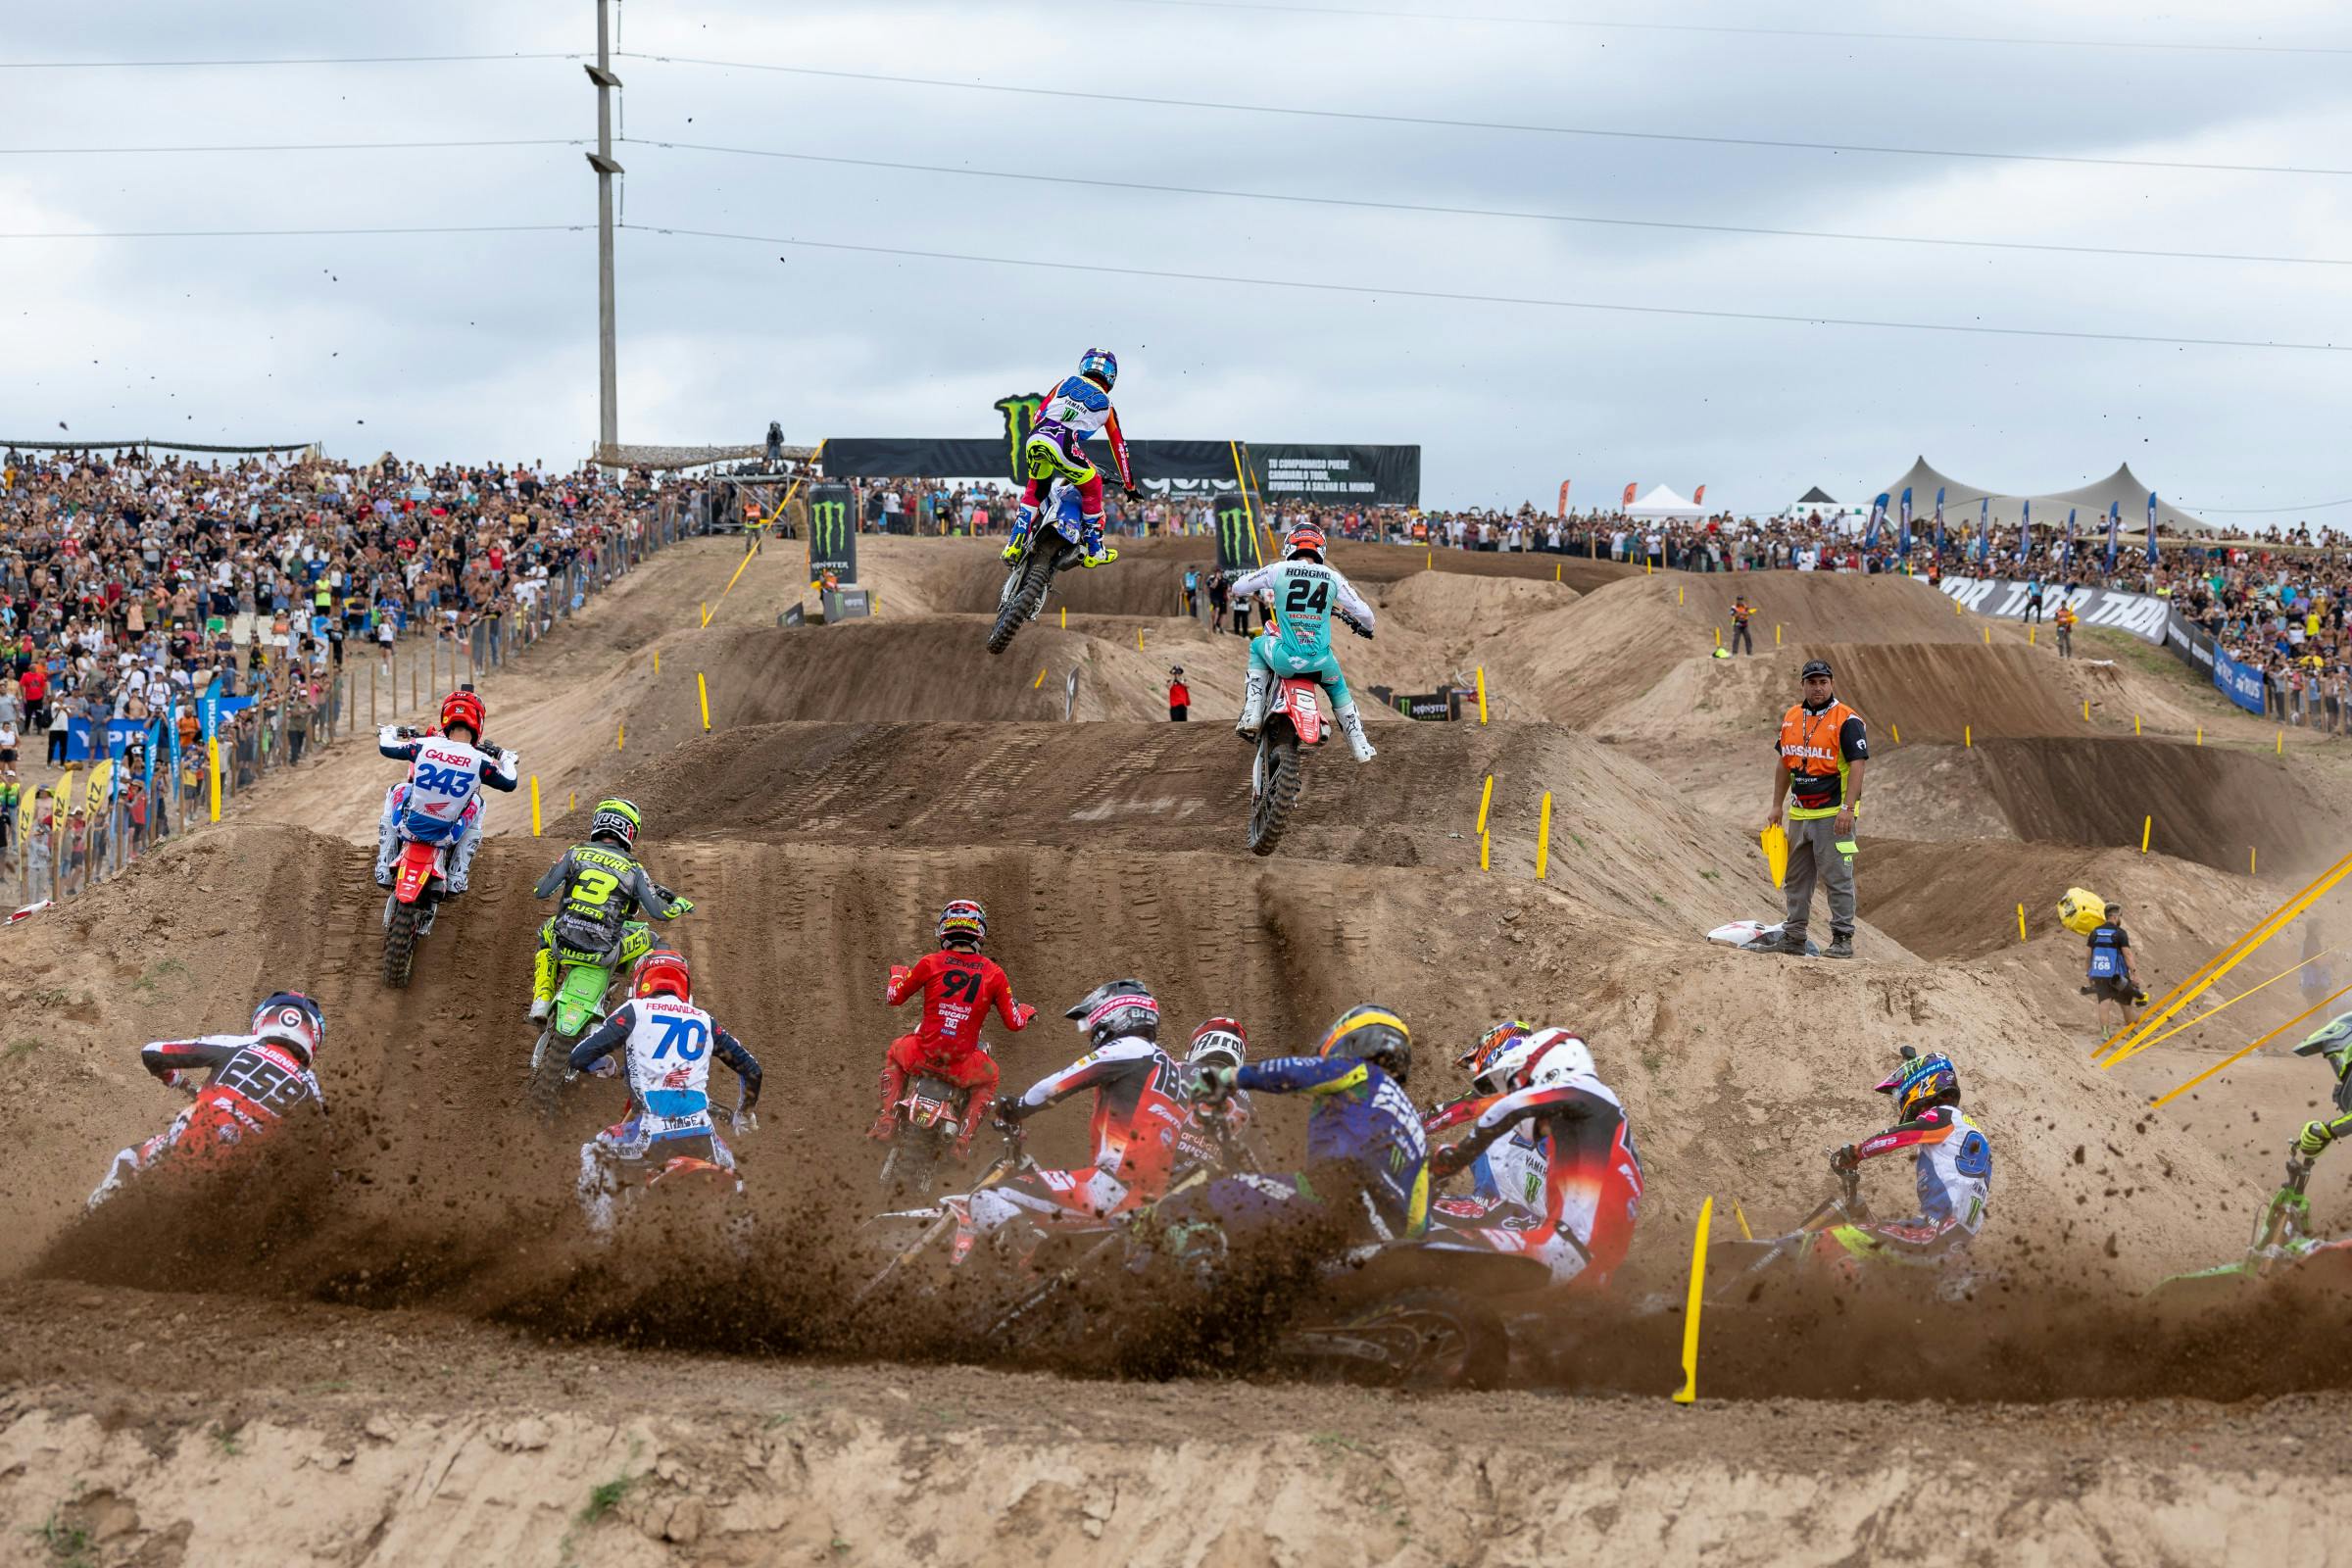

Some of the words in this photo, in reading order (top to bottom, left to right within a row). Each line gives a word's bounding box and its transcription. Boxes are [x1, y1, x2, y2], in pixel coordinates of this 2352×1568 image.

[1056, 375, 1109, 412] 959
[1064, 398, 1088, 415] YAMAHA
[1268, 459, 1278, 468] TU
[1279, 459, 1326, 469] COMPROMISO
[1328, 460, 1349, 469] PUEDE
[1305, 481, 1311, 491] A
[1312, 482, 1339, 492] SALVAR
[1340, 482, 1348, 492] EL
[1349, 482, 1375, 492] MUNDO
[1285, 567, 1331, 580] HORGMO
[1286, 578, 1329, 613] 24
[2086, 591, 2167, 637] THOR
[1412, 704, 1447, 714] MONSTE
[425, 749, 471, 767] GAJSER
[1782, 745, 1835, 760] MARSHALL
[416, 763, 475, 798] 243
[575, 851, 632, 873] FEBVRE
[571, 868, 619, 906] 3
[563, 914, 606, 933] Kawasaki
[560, 947, 604, 962] JUST1
[940, 969, 982, 1004] 91
[646, 1002, 703, 1018] FERNANDEZ
[938, 1008, 969, 1020] DUCATI
[651, 1014, 708, 1061] 70
[215, 1049, 309, 1117] 259
[1525, 1154, 1547, 1179] YAMAH
